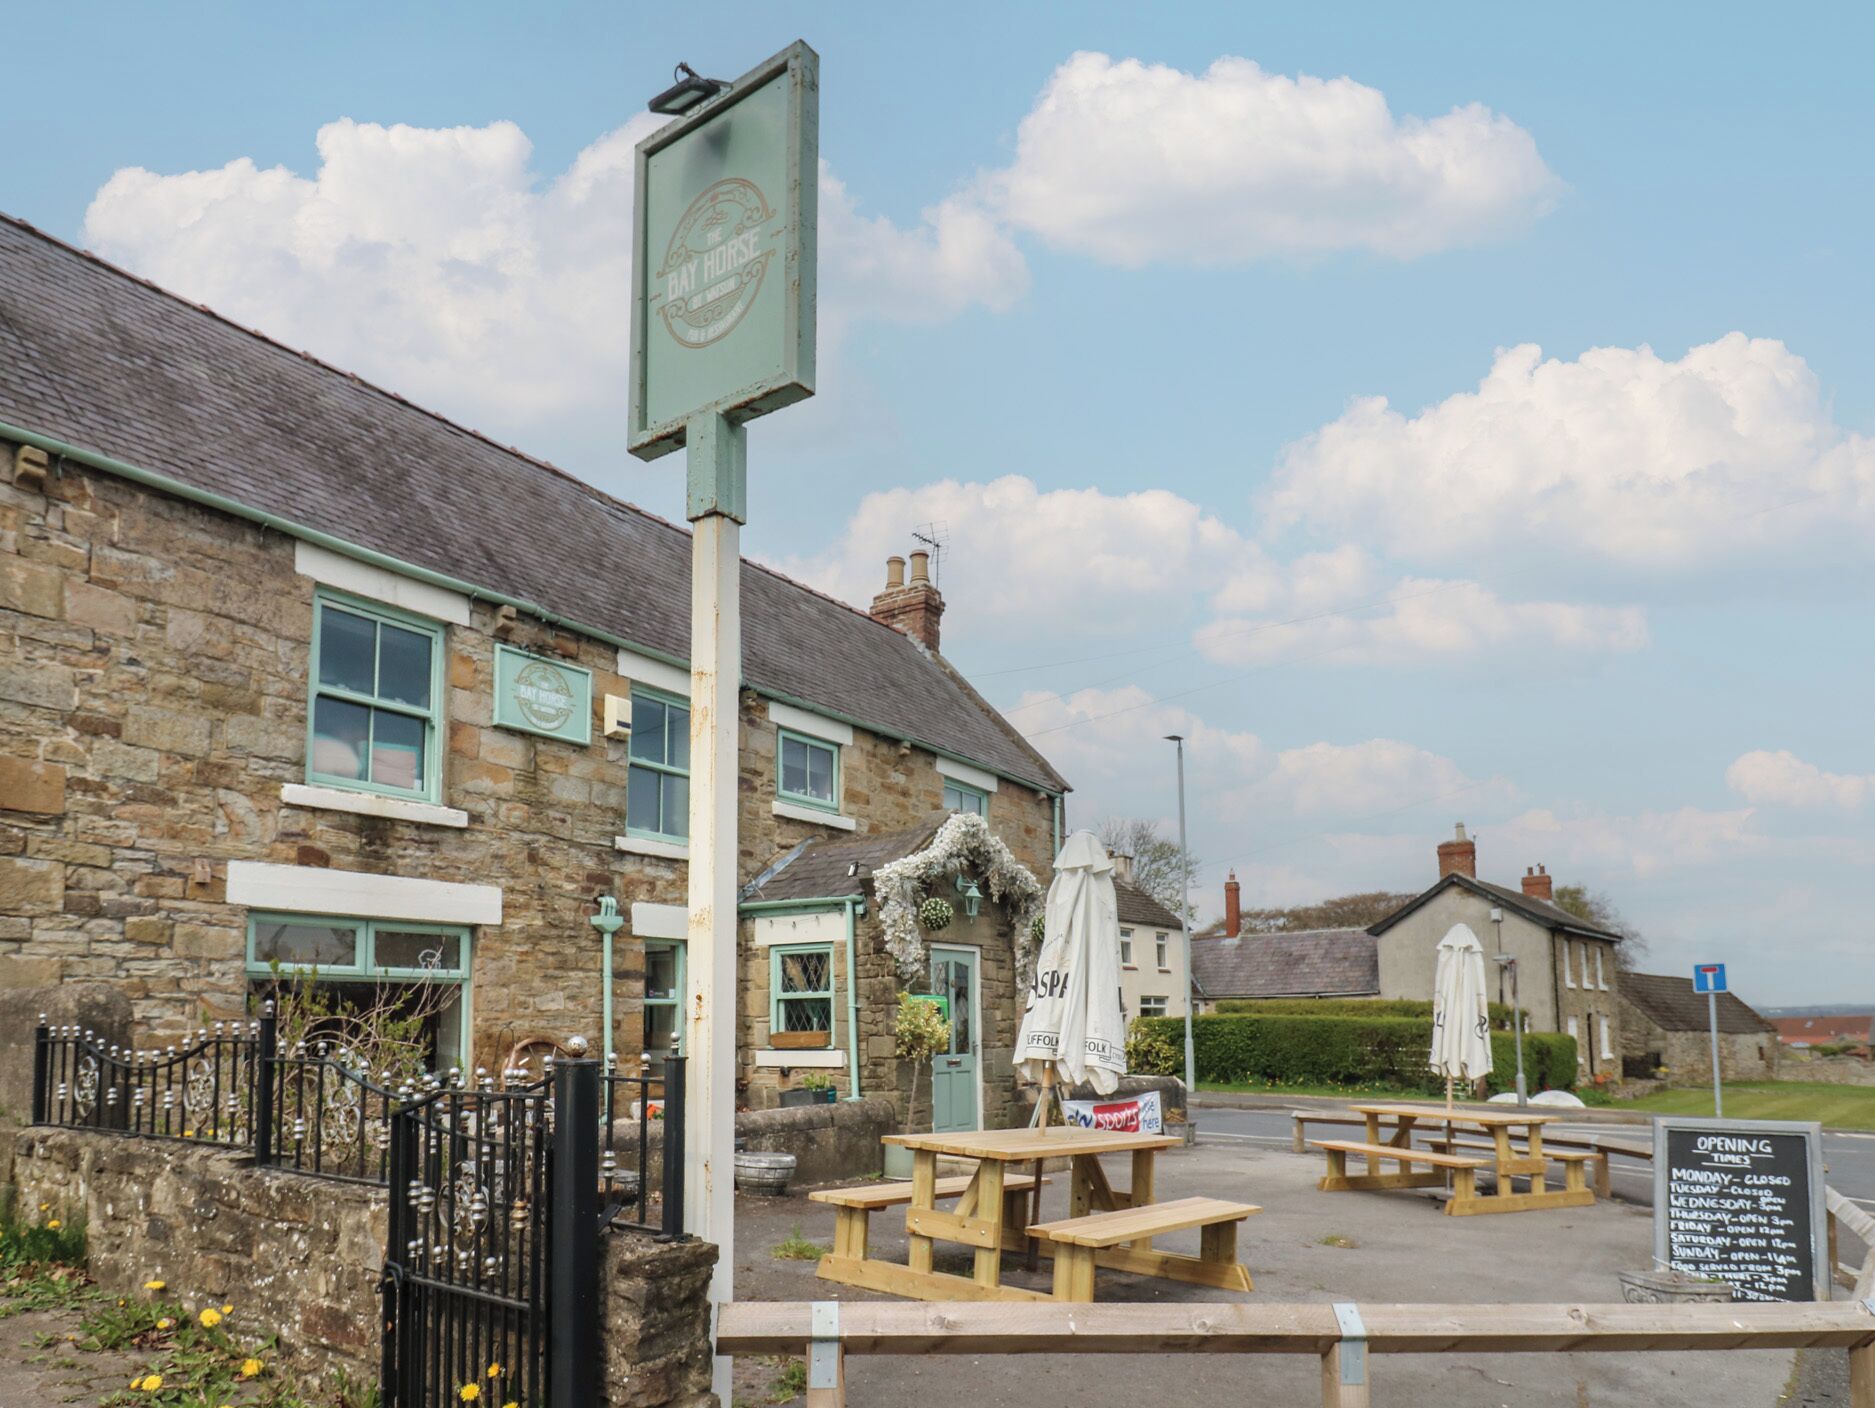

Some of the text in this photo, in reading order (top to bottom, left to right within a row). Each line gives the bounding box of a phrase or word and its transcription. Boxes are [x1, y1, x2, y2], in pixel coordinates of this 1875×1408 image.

[668, 260, 698, 302] BAY
[704, 227, 761, 282] HORSE
[520, 684, 536, 702] BAY
[539, 689, 568, 709] HORSE
[1097, 1108, 1138, 1130] sports
[1697, 1136, 1772, 1153] OPENING
[1710, 1152, 1750, 1164] TIMES
[1672, 1168, 1732, 1185] MONDAY
[1744, 1174, 1791, 1186] CLOSED
[1670, 1183, 1720, 1194] TUESDAY
[1670, 1195, 1751, 1210] WEDNESDAY
[1670, 1208, 1732, 1224] THURSDAY
[1740, 1214, 1768, 1224] OPEN
[1670, 1222, 1711, 1233] FRIDAY
[1727, 1226, 1756, 1234] OPEN
[1671, 1233, 1731, 1247] SATURDAY
[1739, 1238, 1766, 1248] OPEN
[1672, 1244, 1720, 1260] SUNDAY
[1730, 1253, 1759, 1261] OPEN
[1740, 1264, 1772, 1272] FROM
[1774, 1264, 1802, 1276] 3pm
